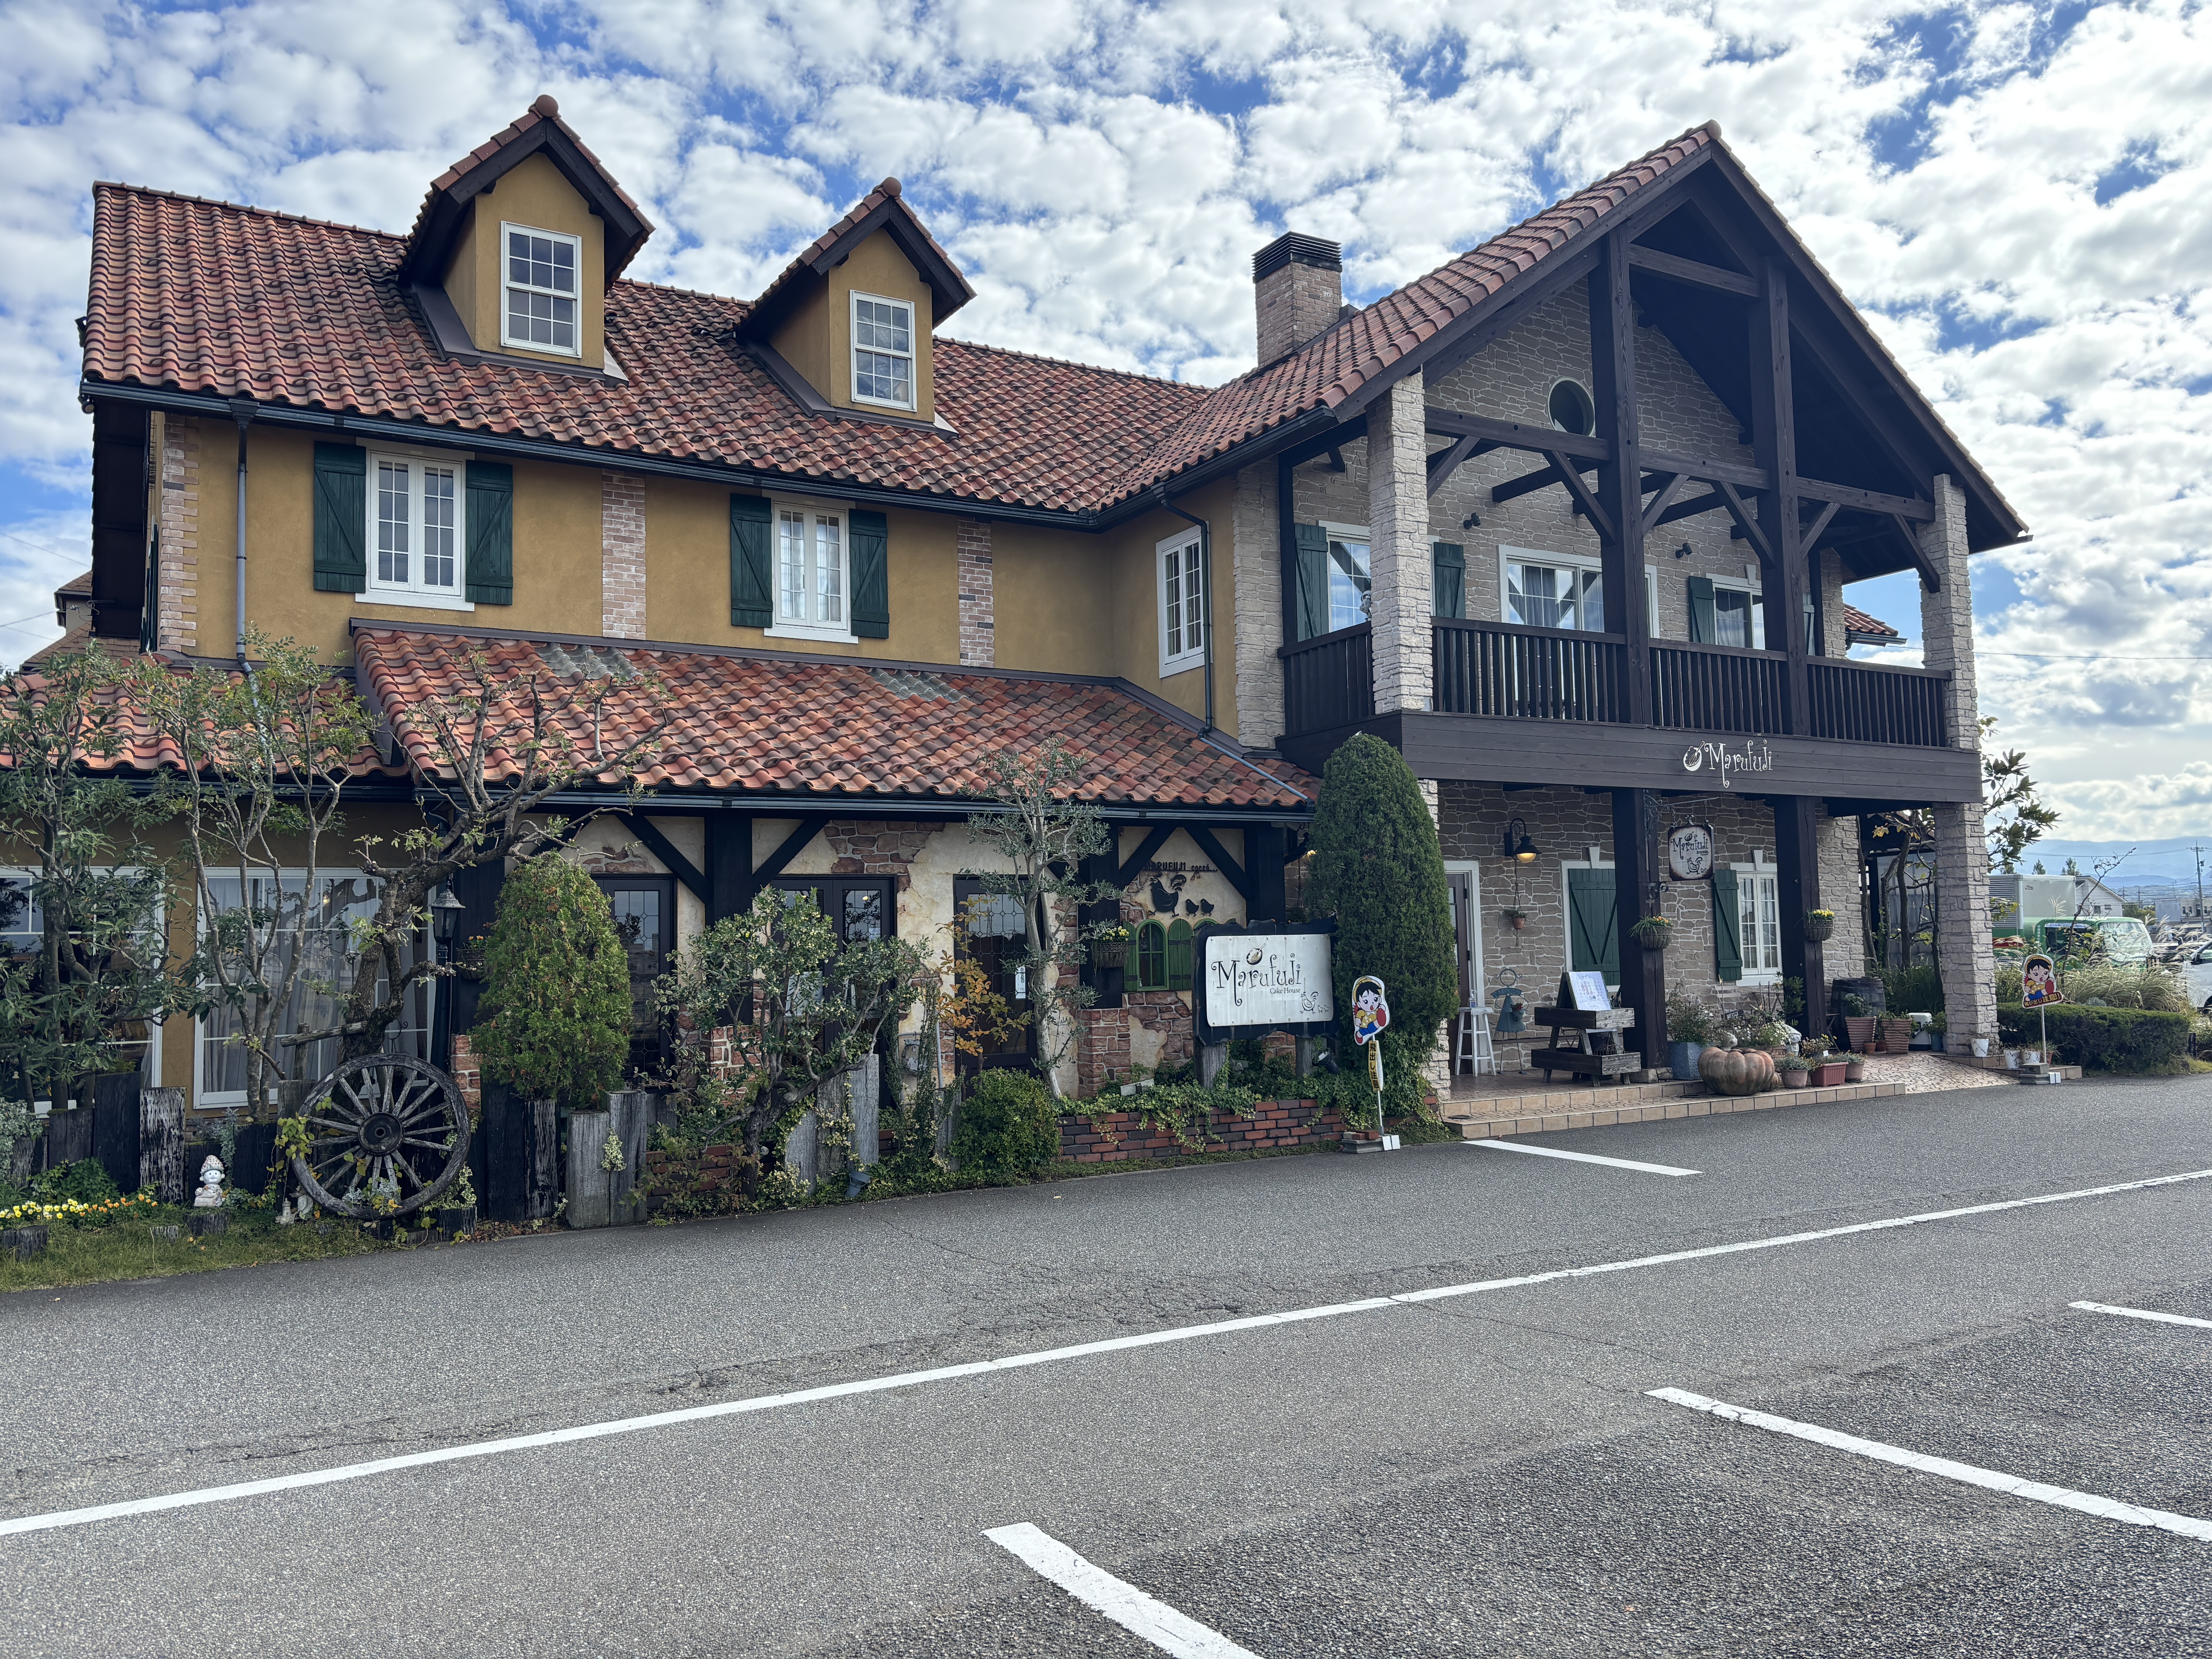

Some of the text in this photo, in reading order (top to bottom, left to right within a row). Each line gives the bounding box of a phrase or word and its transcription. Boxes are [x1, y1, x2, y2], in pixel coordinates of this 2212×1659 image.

[1370, 1043, 1379, 1089] 飛出し注意
